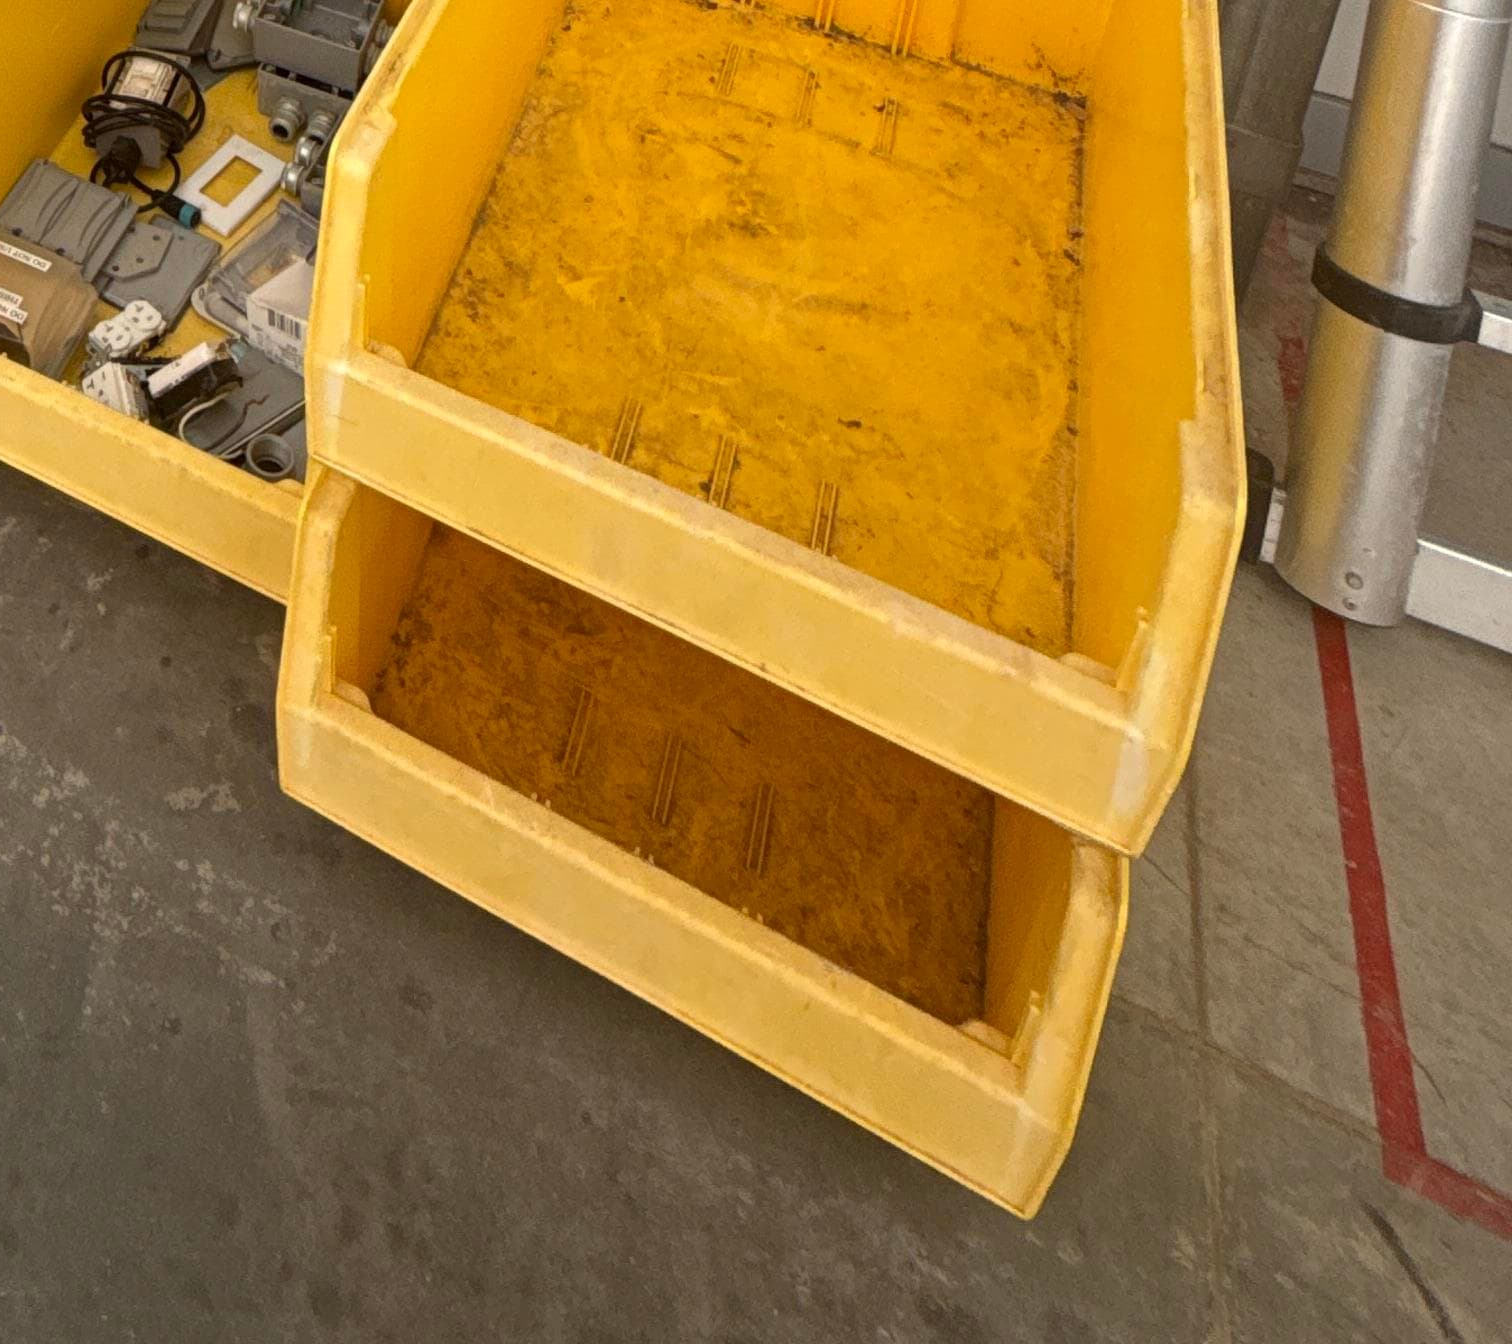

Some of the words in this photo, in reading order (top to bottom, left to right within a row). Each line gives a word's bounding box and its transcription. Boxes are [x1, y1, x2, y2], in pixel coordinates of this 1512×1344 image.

[13, 252, 31, 262] NOT
[32, 258, 47, 269] DO
[9, 309, 25, 321] DO
